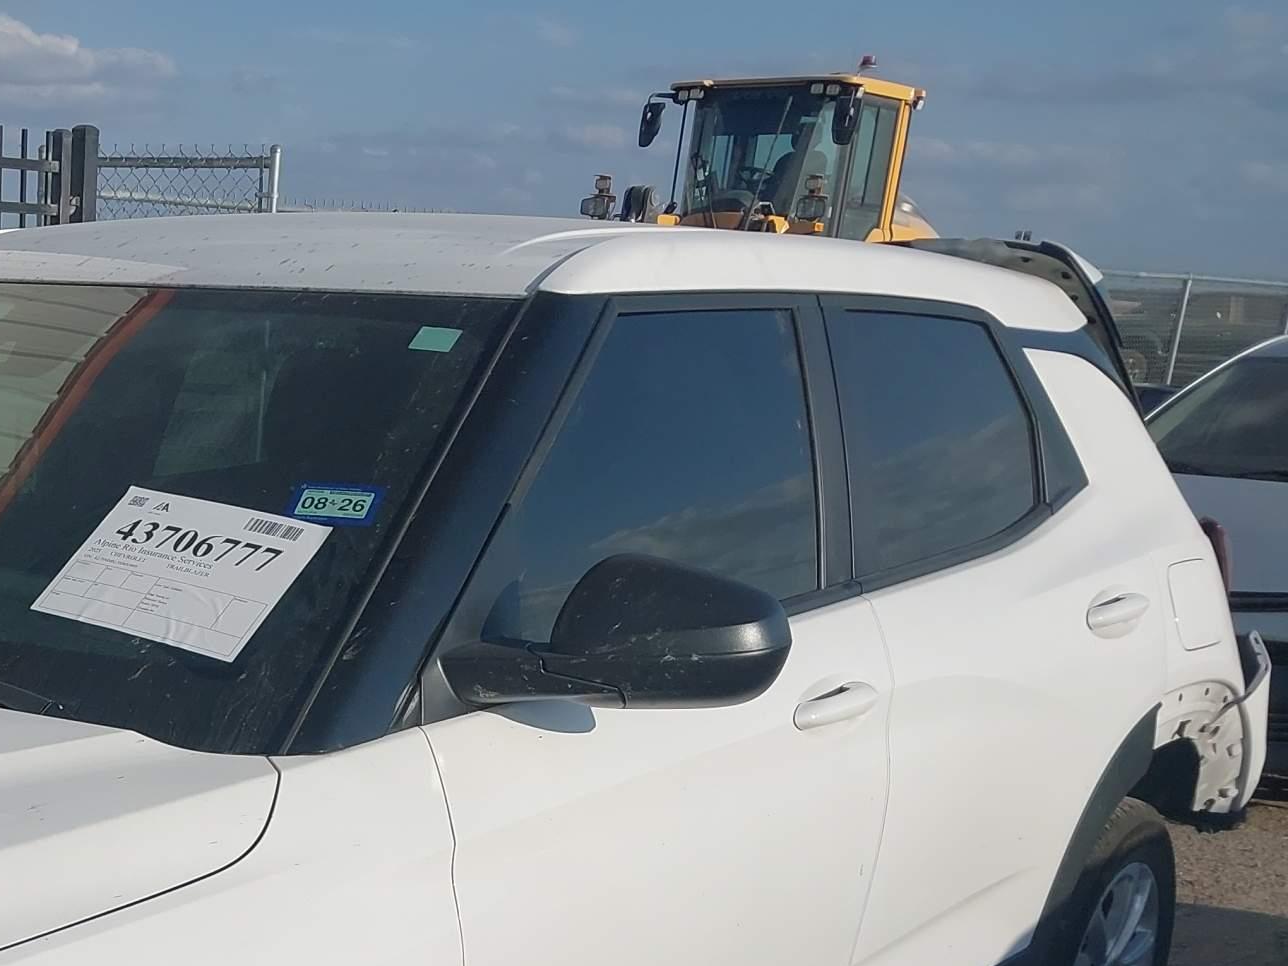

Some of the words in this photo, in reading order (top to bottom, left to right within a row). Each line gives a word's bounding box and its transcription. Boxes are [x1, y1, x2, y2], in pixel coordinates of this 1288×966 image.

[301, 496, 328, 510] 08
[337, 498, 367, 513] 26
[93, 538, 122, 550] Alpine
[121, 542, 137, 552] Rio
[137, 545, 177, 562] Insurance
[178, 555, 214, 570] Services
[115, 519, 283, 572] 43706777
[166, 563, 211, 578] TRAILBLAZER
